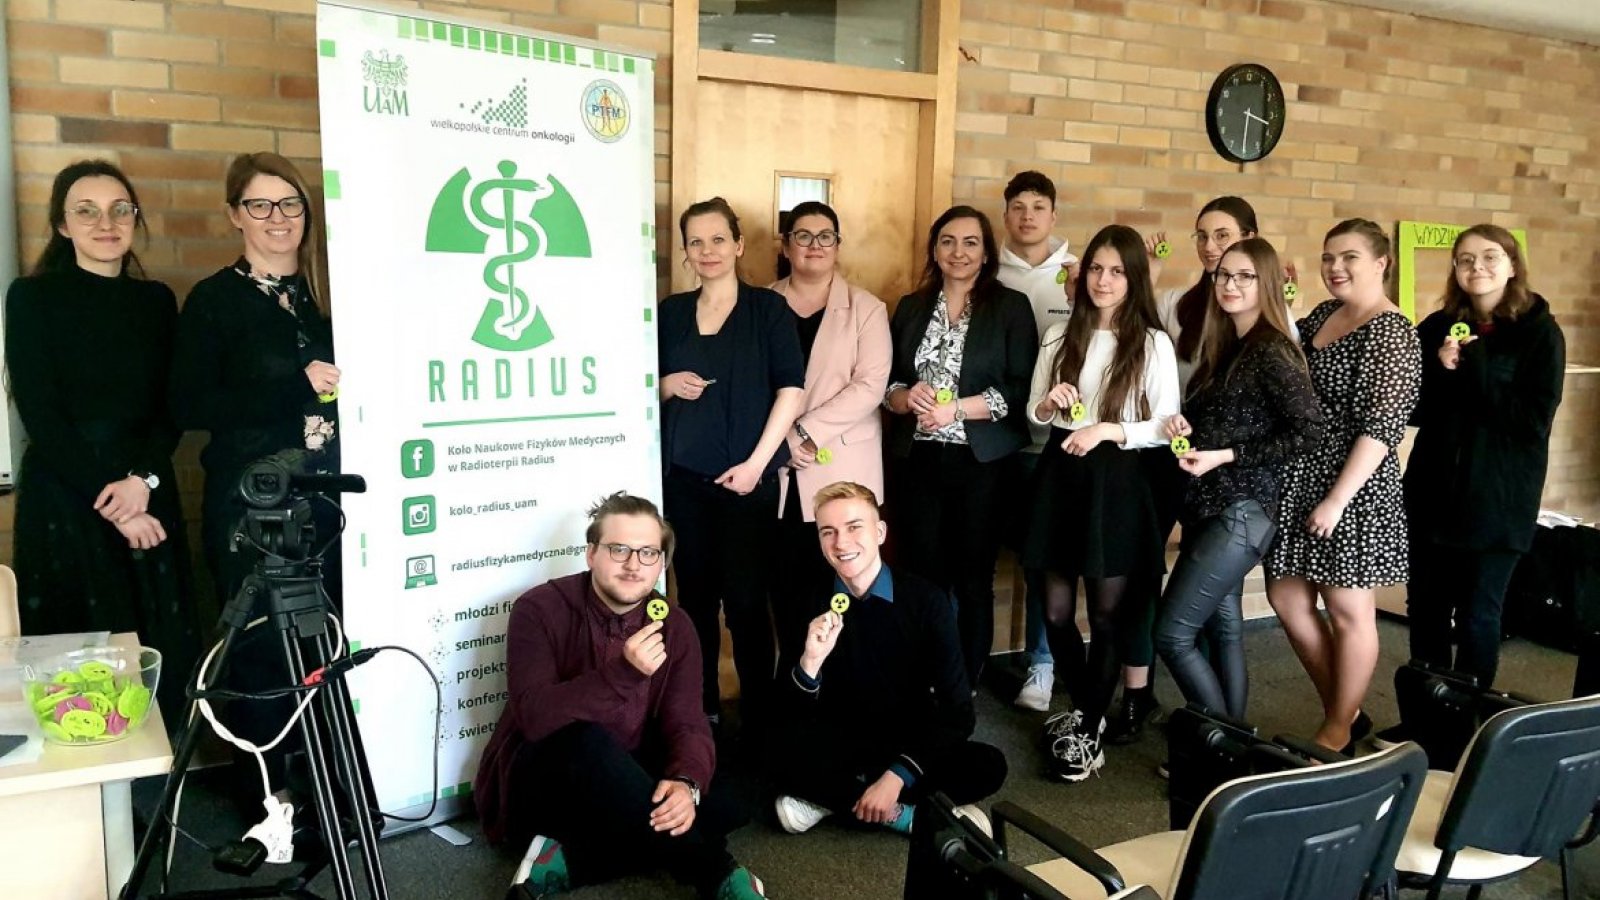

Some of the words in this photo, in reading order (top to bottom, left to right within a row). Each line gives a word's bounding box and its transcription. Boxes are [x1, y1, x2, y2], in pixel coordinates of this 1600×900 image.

[363, 85, 409, 117] UAM
[430, 118, 491, 135] wielkopolskie
[492, 126, 529, 139] centrum
[531, 130, 576, 144] onkologii
[1413, 223, 1459, 246] WYDZIA
[428, 356, 597, 402] RADIUS
[474, 441, 525, 454] Naukowe
[526, 436, 567, 451] Fizyków
[568, 433, 626, 447] Medycznych
[448, 463, 458, 472] w
[460, 458, 519, 472] Radioterpii
[521, 455, 555, 466] Radius
[449, 498, 538, 516] kolo_radius_uam
[454, 602, 498, 622] młodzi
[503, 600, 516, 614] fi
[455, 633, 506, 651] seminar
